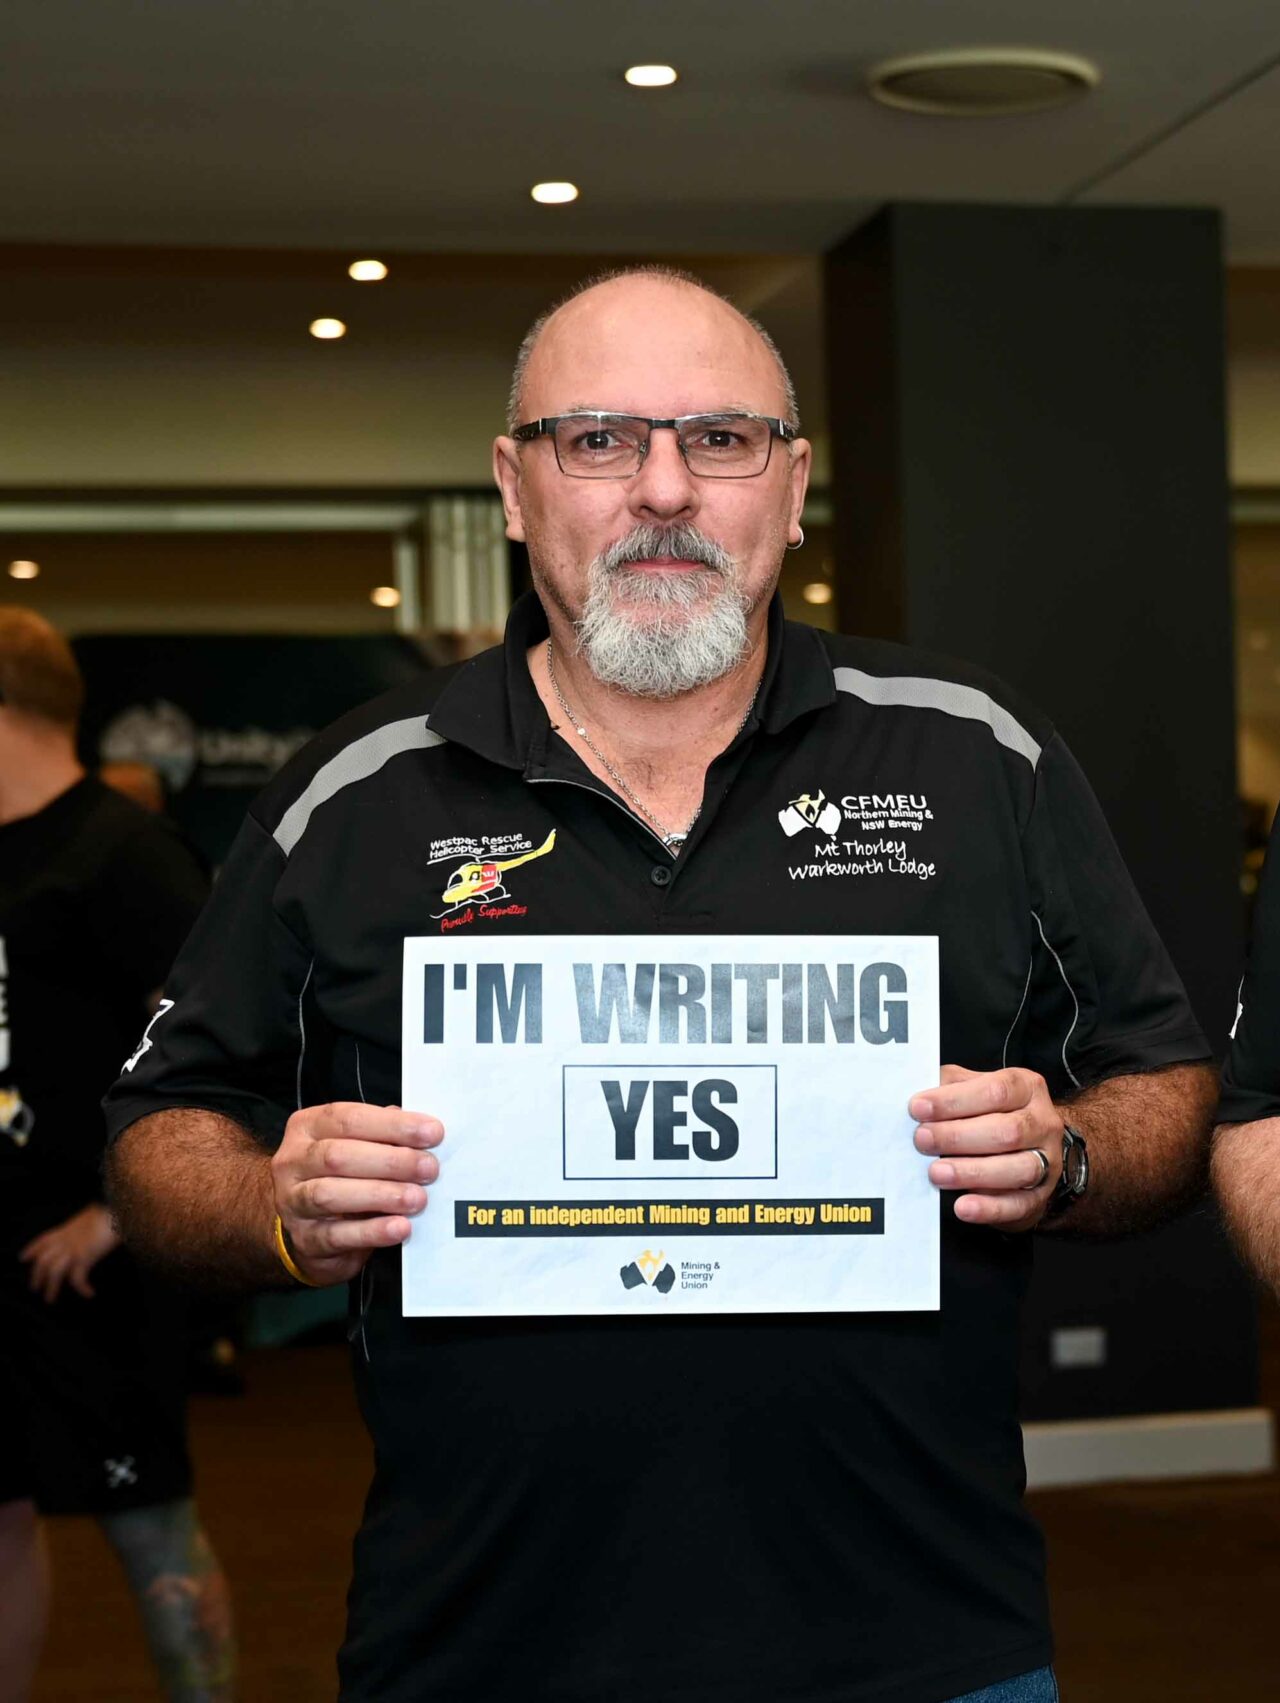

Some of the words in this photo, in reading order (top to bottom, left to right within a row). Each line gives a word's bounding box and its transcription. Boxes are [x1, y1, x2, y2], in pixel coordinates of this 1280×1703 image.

[841, 794, 927, 810] CFMEU
[844, 809, 888, 820] Northern
[890, 808, 923, 820] Mining
[925, 809, 934, 820] &
[861, 820, 885, 831] NSW
[888, 819, 923, 831] Energy
[429, 845, 485, 859] Helicopter
[490, 840, 532, 853] Service
[430, 836, 478, 851] Westpac
[481, 833, 523, 845] Rescue
[815, 842, 840, 858] Mt
[842, 838, 906, 861] Thorley
[788, 860, 883, 880] Warkworth
[888, 857, 936, 880] Lodge
[423, 963, 543, 1044] I'M
[572, 961, 909, 1045] WRITING
[600, 1078, 740, 1162] YES
[467, 1206, 496, 1225] For
[502, 1207, 525, 1225] an
[530, 1206, 644, 1226] independent
[649, 1205, 710, 1225] Mining
[716, 1205, 749, 1223] and
[755, 1205, 815, 1225] Energy
[820, 1204, 872, 1223] Union
[681, 1262, 711, 1272] Mining
[714, 1262, 720, 1270] &
[681, 1271, 714, 1281] Energy
[681, 1281, 708, 1289] Union
